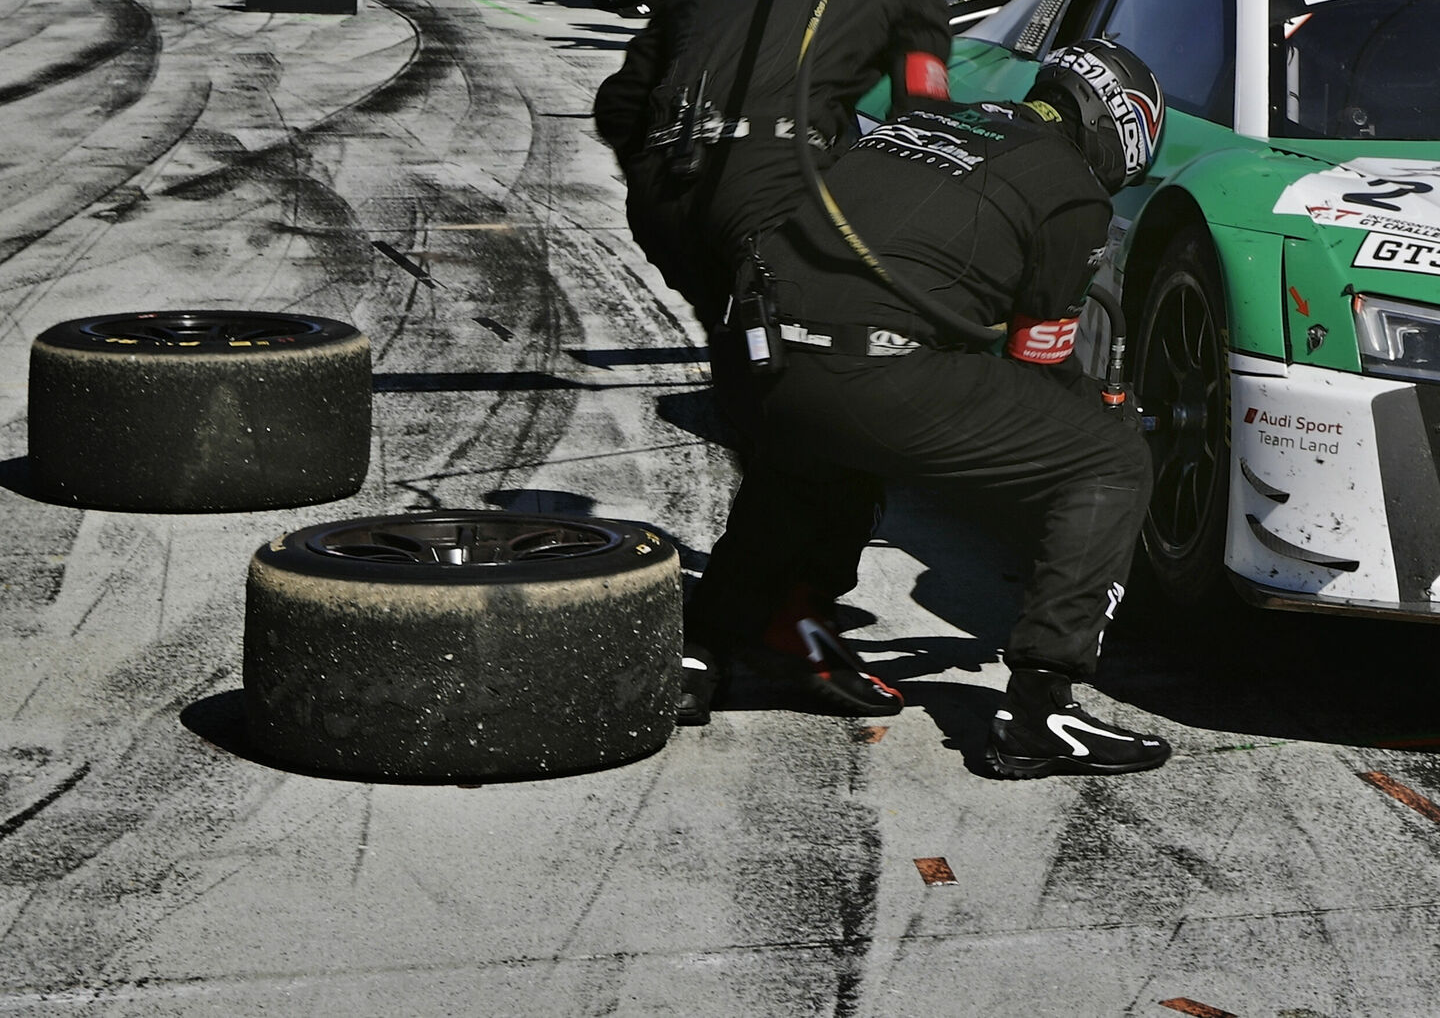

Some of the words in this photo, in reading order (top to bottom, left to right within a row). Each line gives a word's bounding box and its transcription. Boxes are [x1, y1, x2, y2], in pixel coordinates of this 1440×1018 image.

[1358, 218, 1382, 228] GT
[1259, 410, 1292, 429] Audi
[1295, 416, 1343, 438] Sport
[1257, 430, 1293, 450] Team
[1296, 435, 1340, 455] Land
